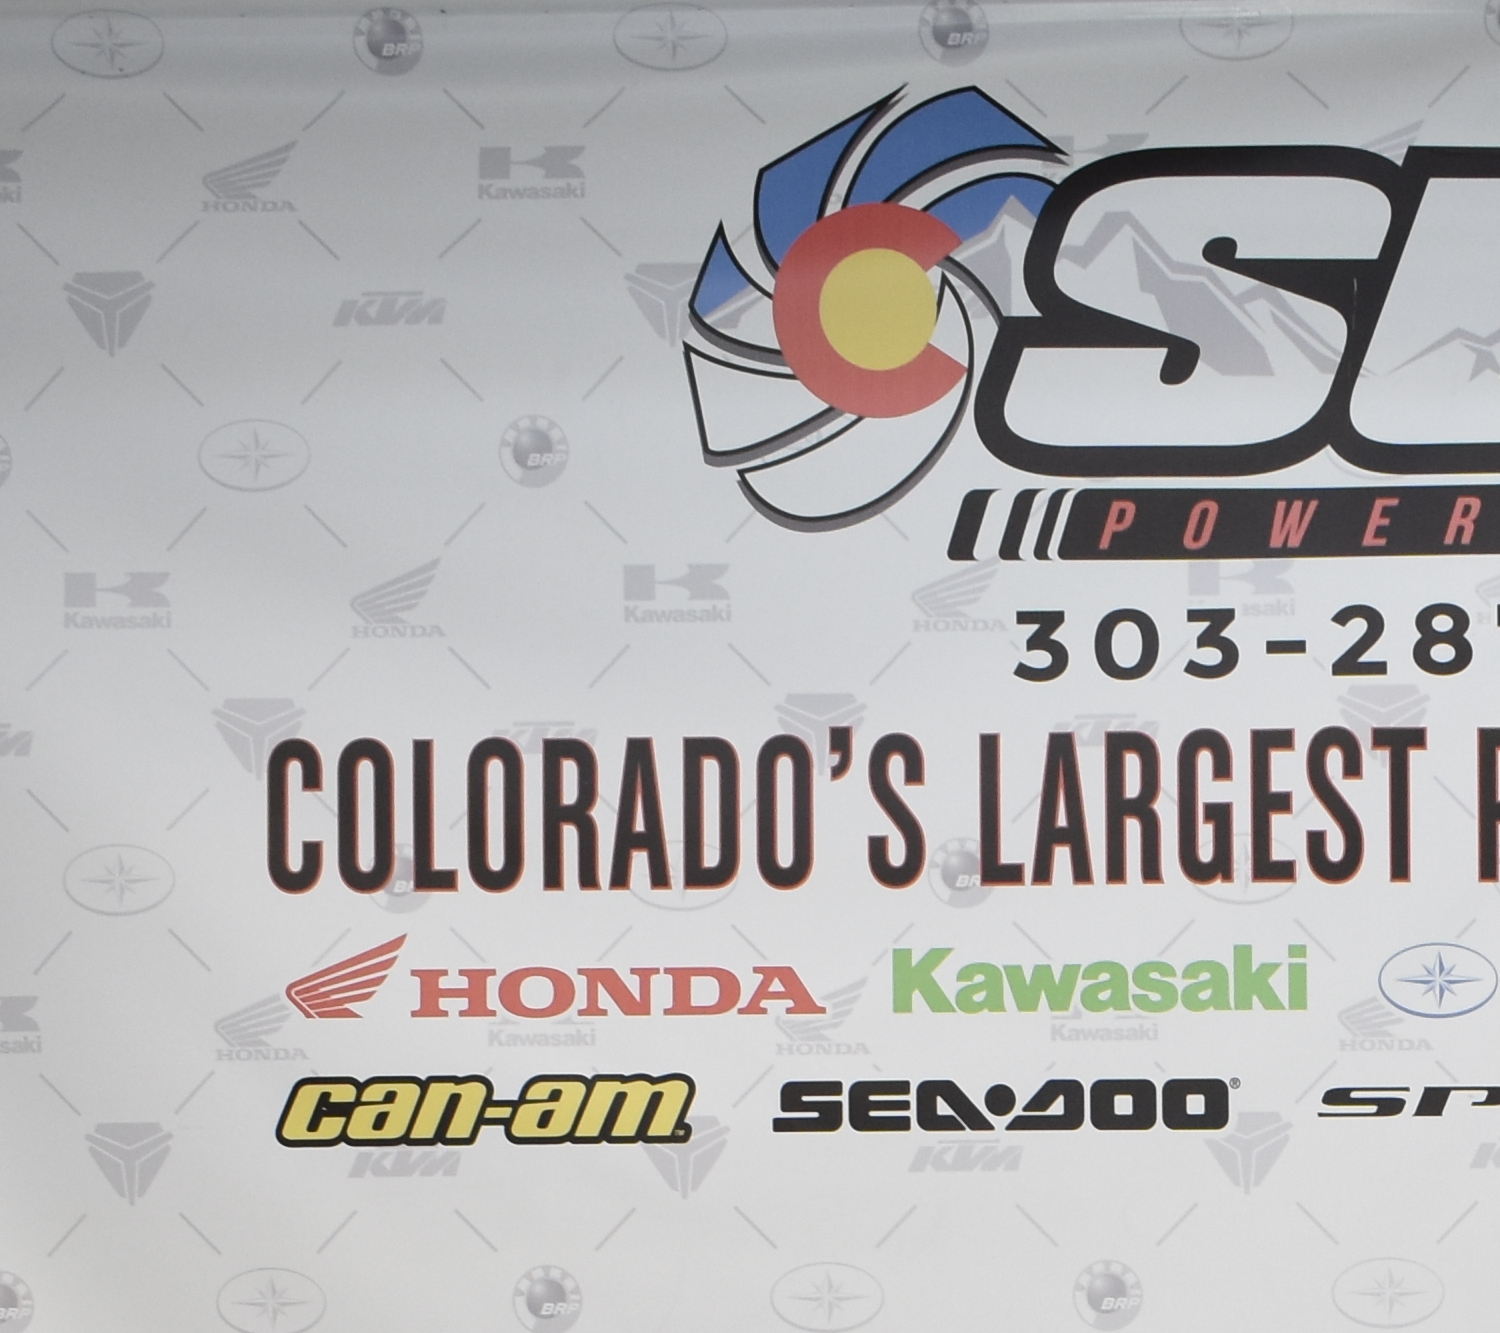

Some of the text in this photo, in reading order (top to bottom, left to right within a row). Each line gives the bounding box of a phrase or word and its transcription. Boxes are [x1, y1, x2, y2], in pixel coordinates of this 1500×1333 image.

[477, 181, 585, 201] Kawasaki
[201, 199, 298, 213] HONDA
[331, 289, 448, 327] KTM
[62, 609, 172, 631] Kawasaki
[623, 603, 731, 625] Kawasaki
[912, 617, 1009, 633] HONDA
[350, 623, 447, 639] HONDA
[266, 726, 927, 895] COLORADO'S
[978, 726, 1429, 888] LARGEST
[890, 943, 1309, 1015] Kawasaki
[407, 965, 828, 1019] HONDA
[485, 1027, 598, 1049] Kawasaki
[1050, 1021, 1158, 1043] Kawasaki
[215, 1046, 309, 1063] HONDA
[775, 1041, 872, 1056] HONDA
[1338, 1037, 1435, 1052] HONDA
[276, 1071, 696, 1148] can-am
[907, 1138, 1024, 1172] KTM
[539, 1301, 581, 1317] BRP
[1100, 1296, 1141, 1312] BRP
